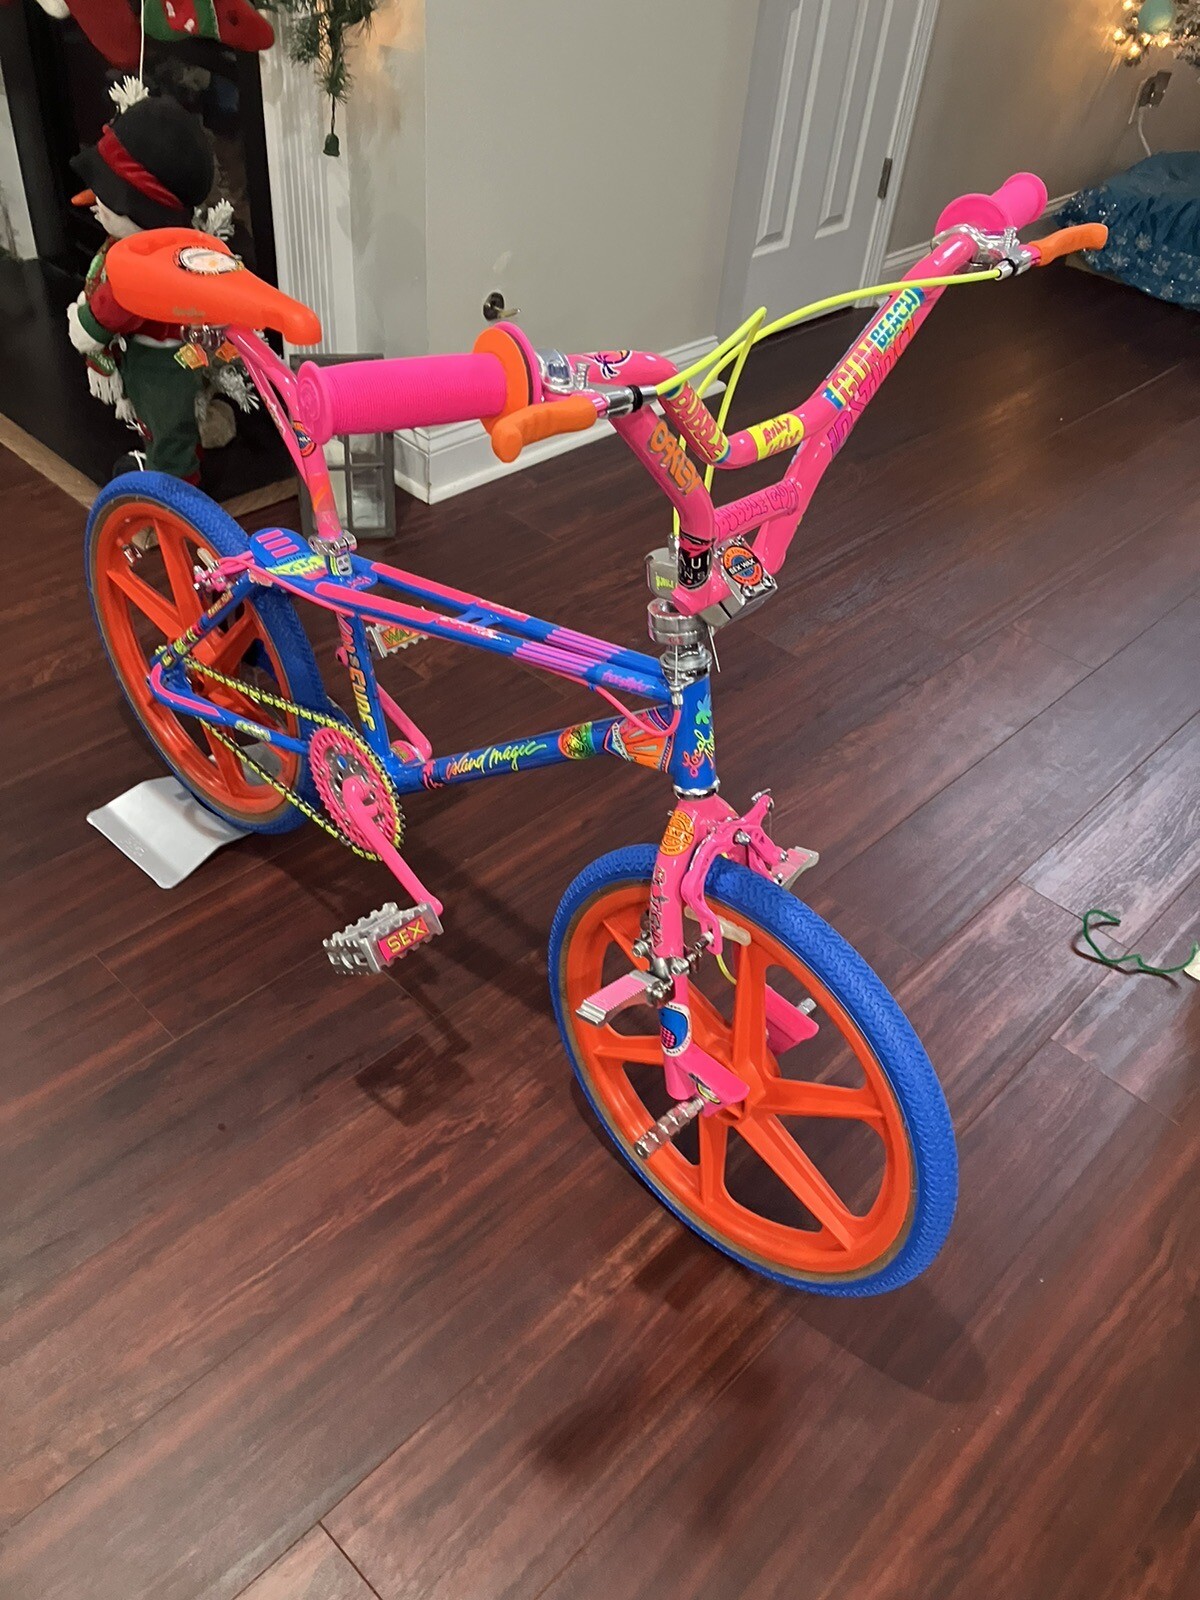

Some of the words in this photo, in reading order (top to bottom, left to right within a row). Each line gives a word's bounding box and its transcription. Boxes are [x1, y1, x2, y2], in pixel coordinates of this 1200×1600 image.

[868, 289, 919, 350] BEACH
[649, 420, 700, 495] OAKLEY
[682, 729, 709, 778] Local
[387, 920, 427, 954] SEX
